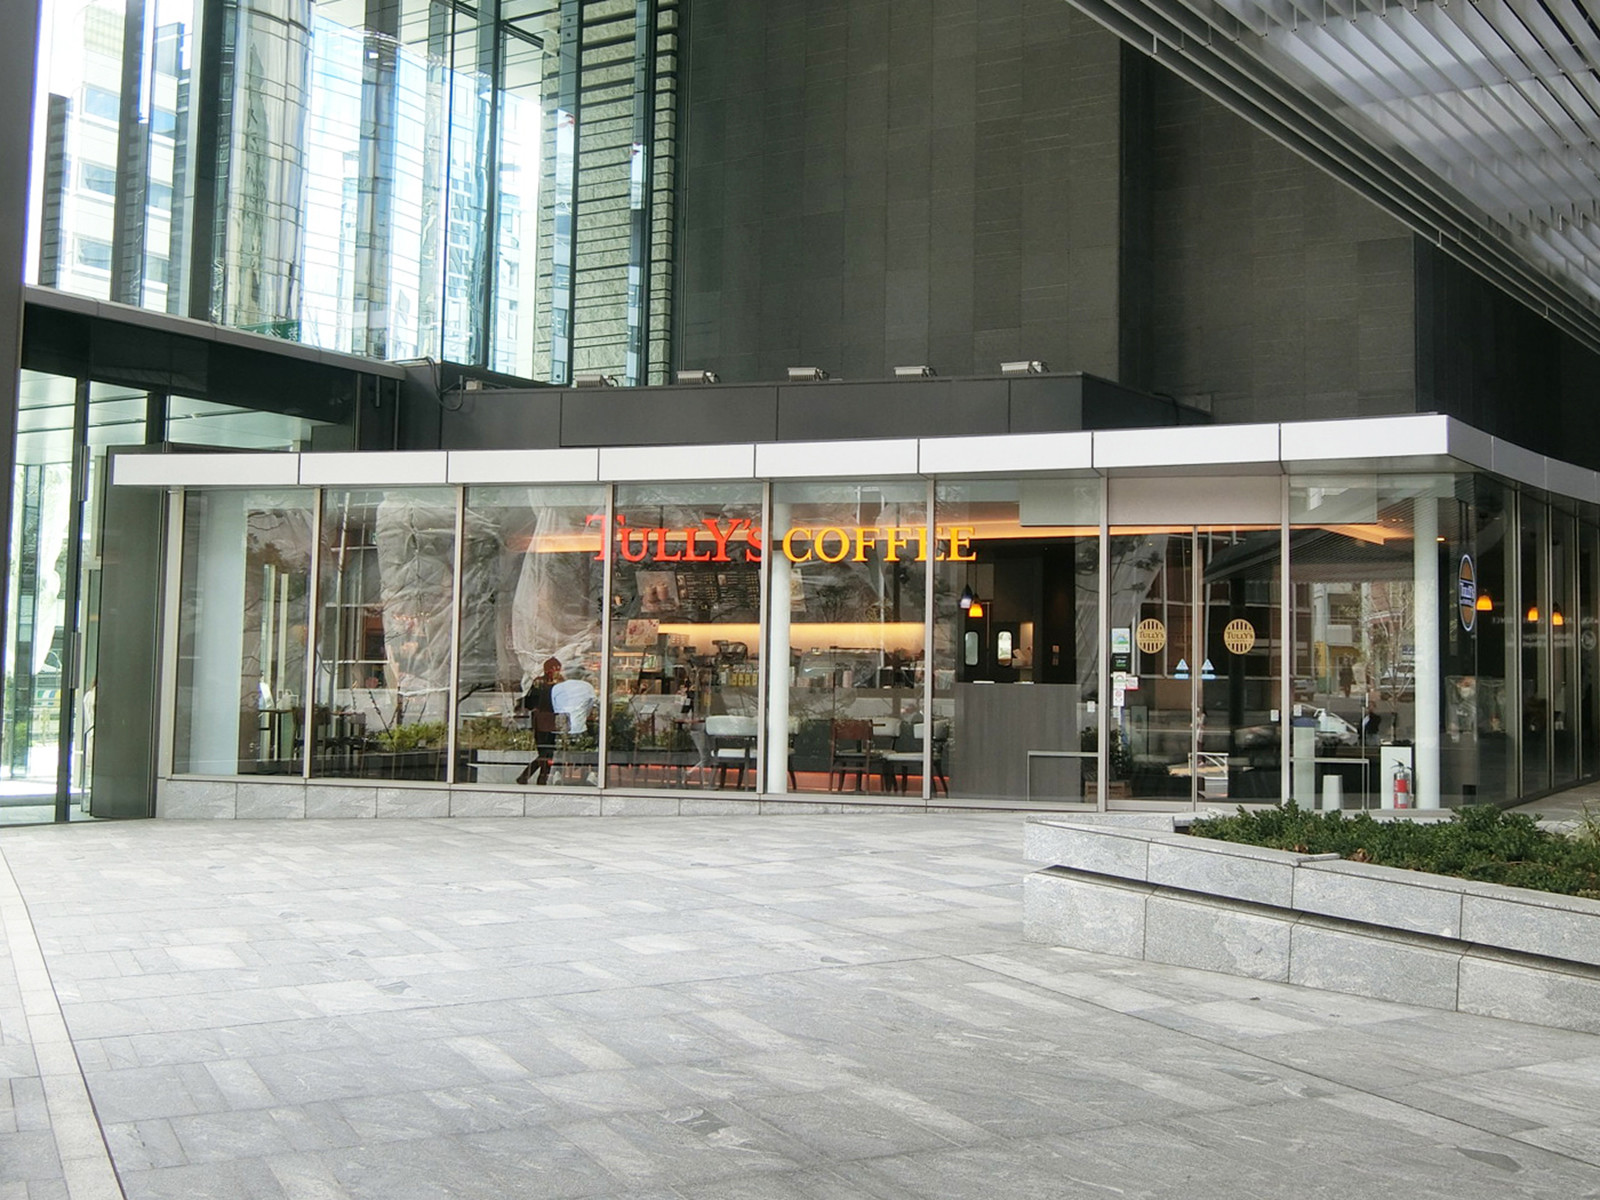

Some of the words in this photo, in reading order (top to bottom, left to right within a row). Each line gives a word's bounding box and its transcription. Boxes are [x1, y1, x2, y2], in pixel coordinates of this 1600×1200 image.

[585, 514, 762, 562] TULLY'S
[782, 526, 977, 563] COFFEE
[1226, 631, 1253, 640] TULLY'S
